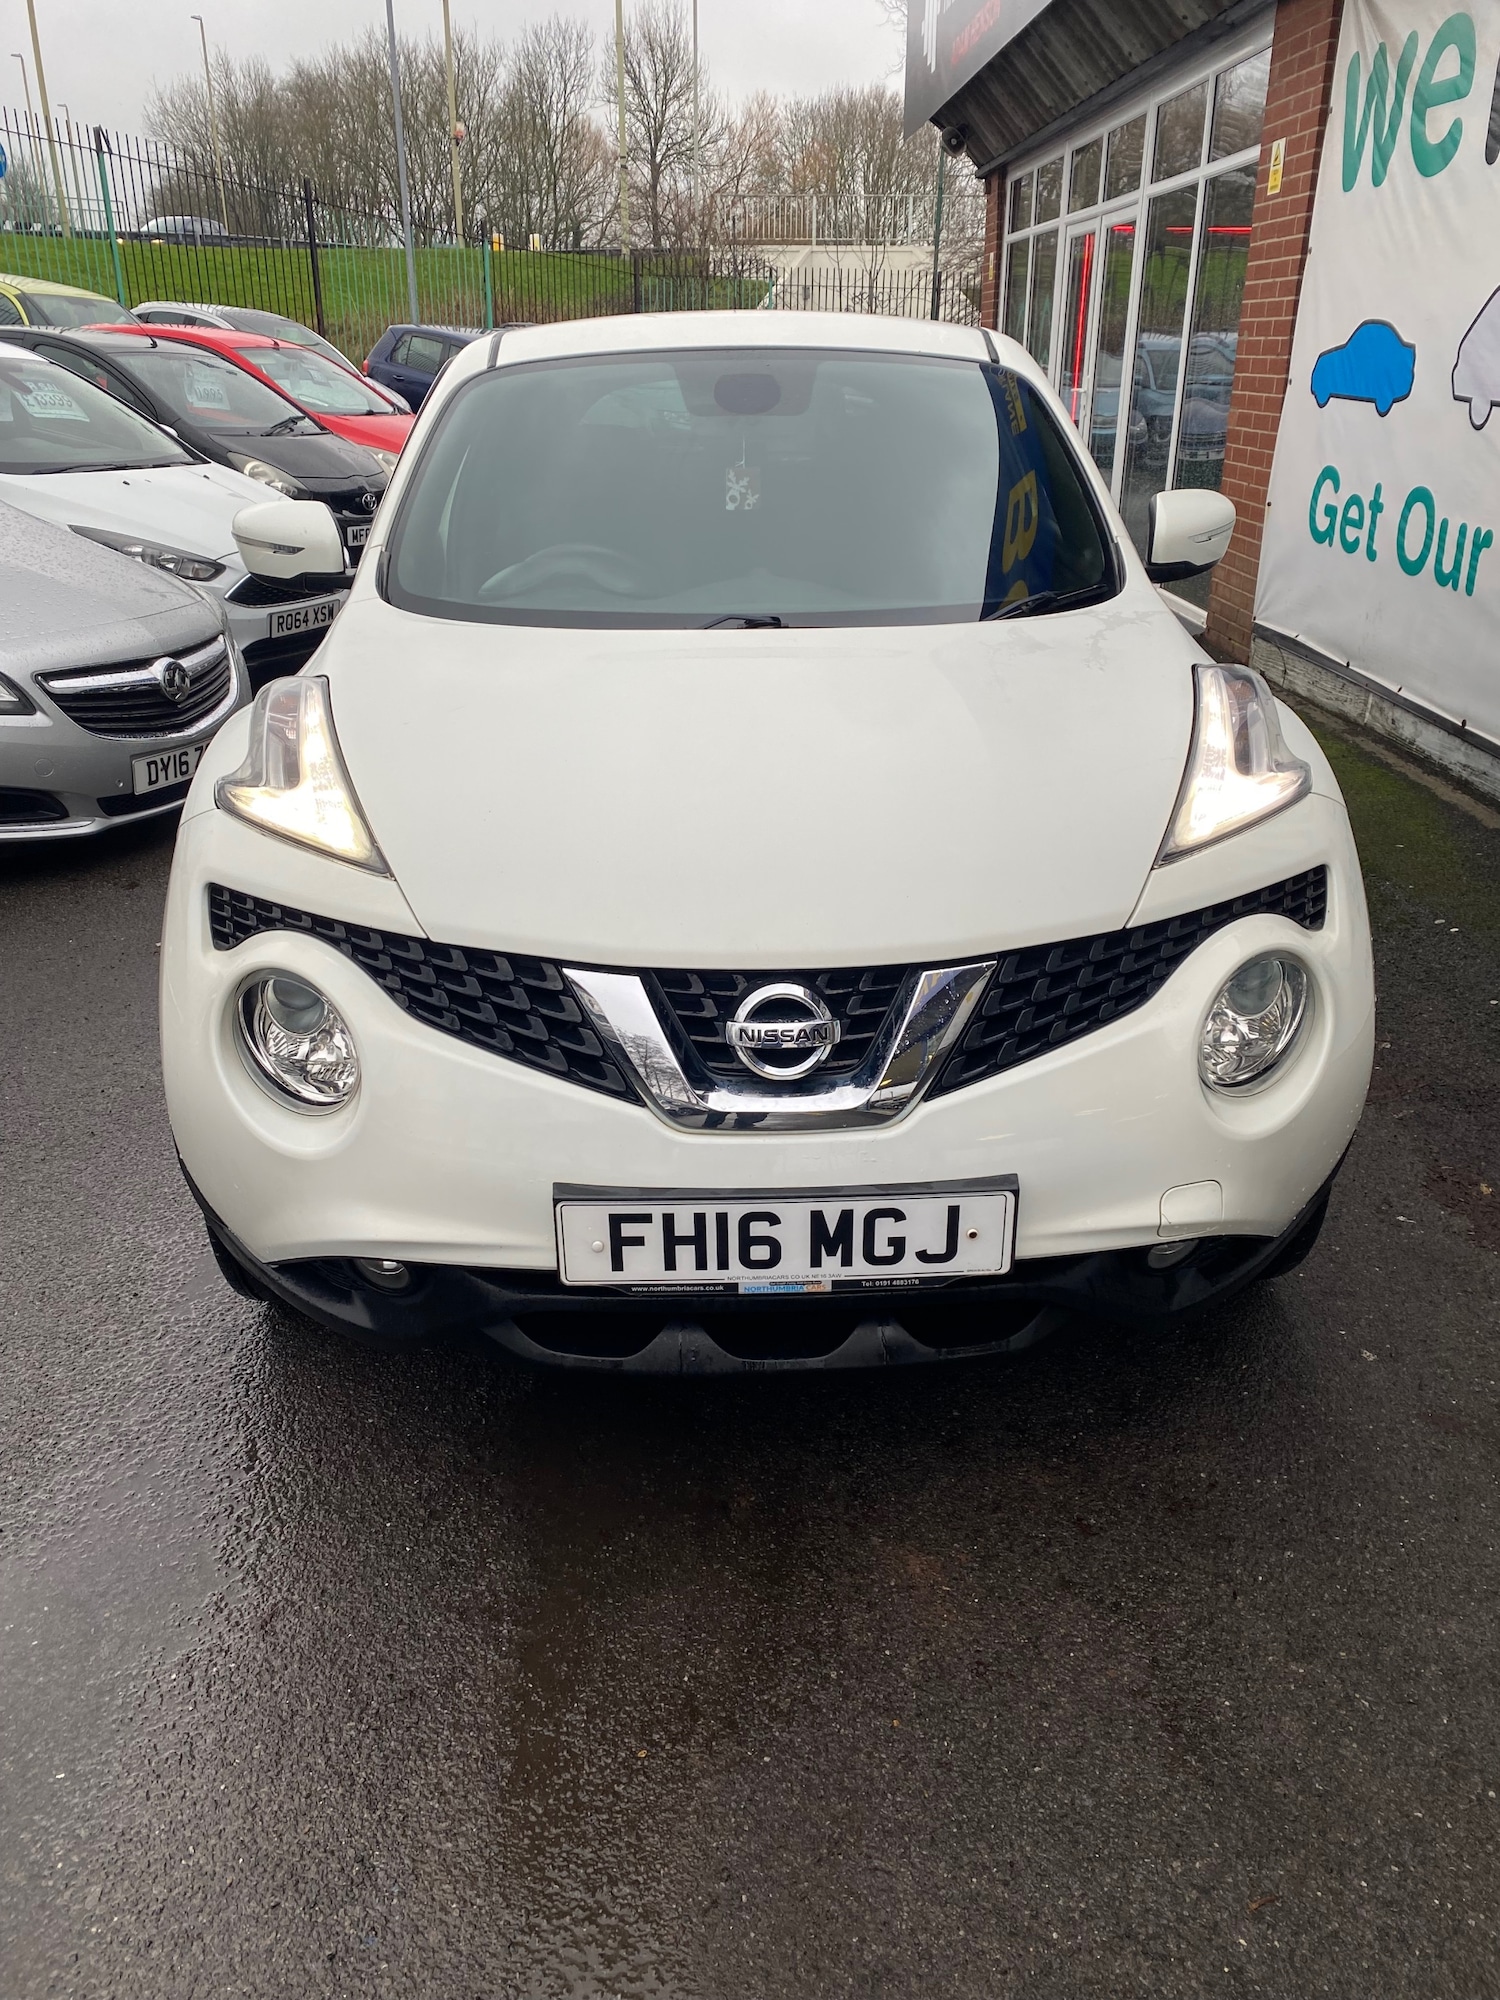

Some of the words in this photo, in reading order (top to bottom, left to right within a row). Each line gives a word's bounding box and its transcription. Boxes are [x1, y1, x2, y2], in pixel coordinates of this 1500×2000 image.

[1309, 465, 1384, 562] Get
[1396, 486, 1494, 596] Our
[277, 610, 309, 633] RO64
[313, 603, 335, 625] XSW
[146, 751, 190, 786] DY16
[739, 1027, 828, 1043] NISSAN
[608, 1211, 782, 1272] FH16
[810, 1205, 960, 1268] MGJ
[631, 1284, 724, 1292] www.northumbriacars.co.uk
